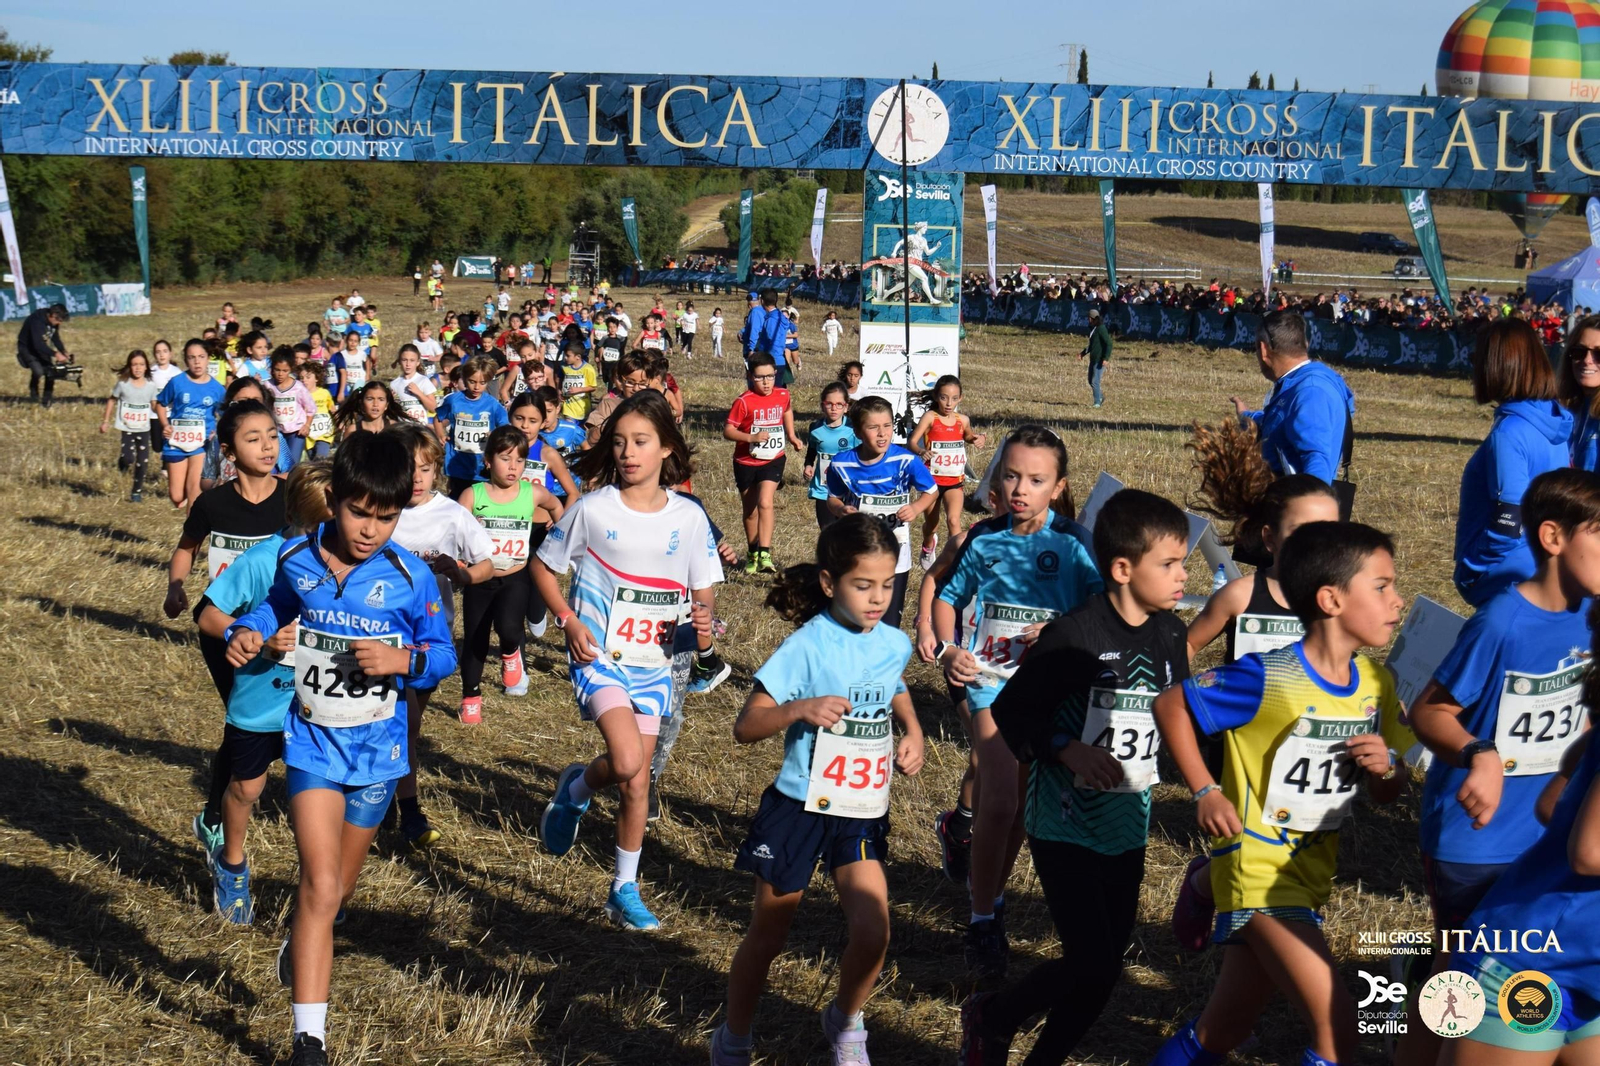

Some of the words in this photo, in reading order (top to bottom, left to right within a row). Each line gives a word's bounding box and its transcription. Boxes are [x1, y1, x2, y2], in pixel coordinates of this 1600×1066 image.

[85, 77, 253, 134] XLIII
[257, 81, 388, 115] CROSS
[448, 72, 767, 149] ITÁLICA
[257, 117, 436, 137] INTERNACIONAL
[998, 94, 1168, 154] XLIII
[1169, 101, 1298, 138] CROSS
[85, 137, 243, 156] INTERNATIONAL
[247, 139, 307, 157] CROSS
[311, 140, 404, 158] COUNTRY
[1168, 136, 1345, 160] INTERNACIONAL
[994, 154, 1151, 174] INTERNATIONAL
[1156, 158, 1215, 176] CROSS
[1220, 160, 1313, 181] COUNTRY
[915, 190, 950, 200] Sevilla
[604, 351, 618, 359] 4241
[123, 412, 148, 422] 4411
[275, 406, 295, 416] 545
[173, 431, 204, 443] 4394
[457, 430, 487, 443] 4102
[934, 454, 966, 467] 4344
[491, 538, 526, 557] 542
[640, 592, 671, 603] ITÁLICA
[997, 608, 1038, 621] ITÁLICA
[1266, 620, 1305, 634] ITÁLIC
[322, 638, 349, 652] ITÁL
[1099, 652, 1121, 661] 42K
[1122, 695, 1150, 710] ITÁL
[1508, 700, 1584, 743] 4237
[1319, 721, 1368, 737] ITÁLICA
